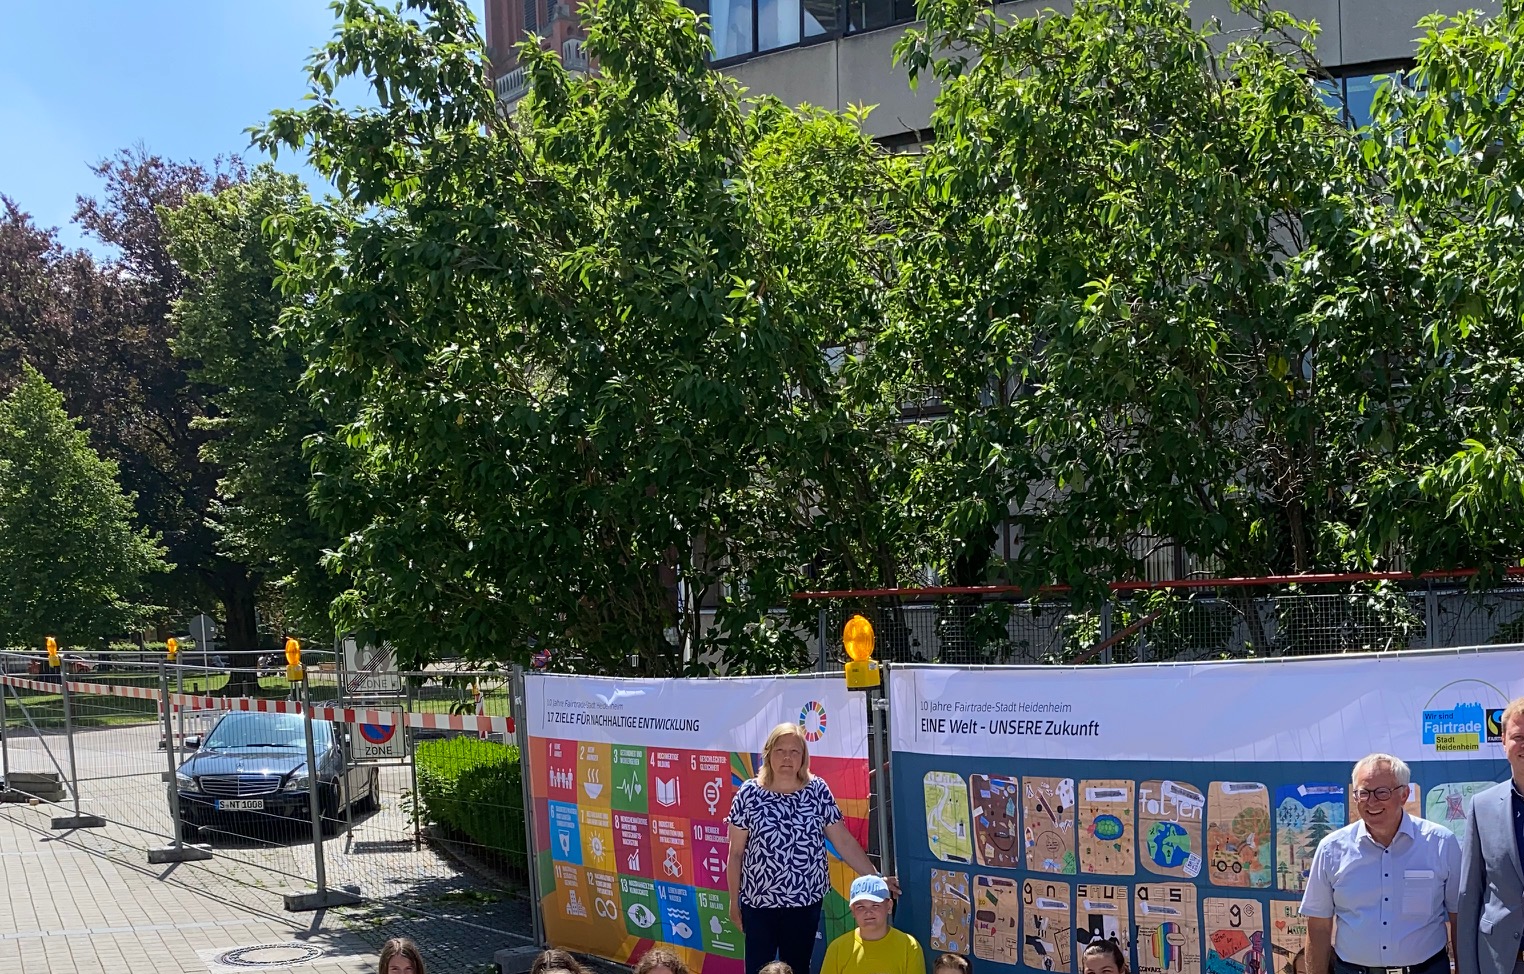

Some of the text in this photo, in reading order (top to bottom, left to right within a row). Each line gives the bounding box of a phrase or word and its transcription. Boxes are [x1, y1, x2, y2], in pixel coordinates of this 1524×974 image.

[920, 701, 1072, 713] 10 Jahre Fairtrade-Stadt Heidenheim
[547, 711, 700, 732] 17 ZIELE FÜR NACHHALTIGE ENTWICKLUNG
[921, 718, 946, 733] EINE
[950, 719, 978, 734] Welt
[989, 719, 1044, 735] UNSERE
[1045, 720, 1100, 737] Zukunft
[1424, 721, 1482, 734] Fairtrade
[1436, 736, 1455, 744] Stadt
[365, 746, 392, 756] ZONE
[549, 742, 552, 757] 1
[580, 746, 585, 760] 2
[613, 749, 618, 764] 3
[650, 752, 656, 768] 4
[690, 755, 697, 771] 5
[550, 805, 555, 819] 6
[580, 809, 585, 823] 7
[614, 814, 620, 829] 8
[652, 820, 658, 835] 9
[693, 825, 703, 841] 10
[555, 865, 563, 879] 11
[587, 871, 595, 886] 12
[620, 878, 629, 893] 13
[657, 885, 667, 900] 14
[698, 893, 708, 908] 15
